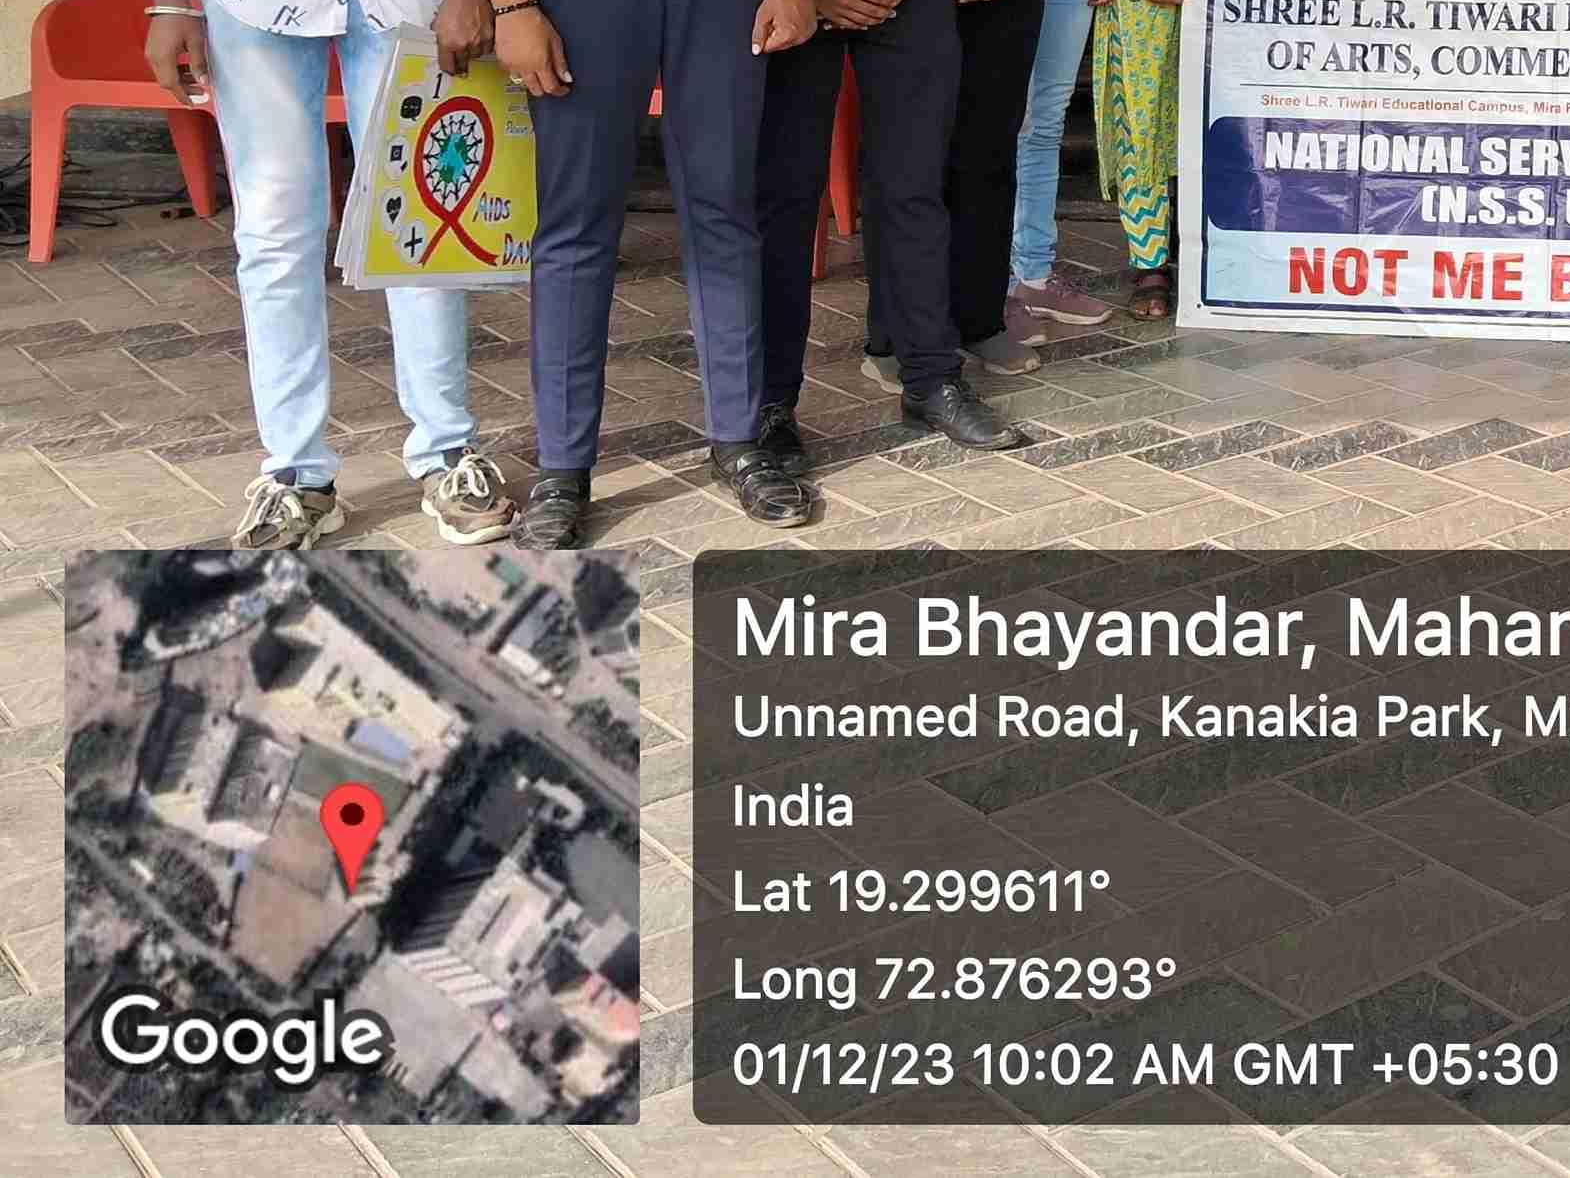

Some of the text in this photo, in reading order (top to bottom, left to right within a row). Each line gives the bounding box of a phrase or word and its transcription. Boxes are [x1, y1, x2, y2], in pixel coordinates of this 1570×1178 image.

[1426, 0, 1557, 32] TIWARI
[1266, 39, 1316, 72] OF
[1320, 41, 1421, 80] ARTS,
[1261, 93, 1301, 108] Shree
[1305, 95, 1331, 109] L.R.
[1337, 95, 1378, 110] Tiwari
[1382, 97, 1465, 112] Educational
[1468, 99, 1530, 115] Campus,
[1533, 101, 1562, 114] Mira
[1265, 131, 1470, 174] NATIONAL
[1420, 183, 1555, 227] (N.S.S.
[1288, 246, 1409, 297] NOT
[1431, 250, 1525, 301] ME
